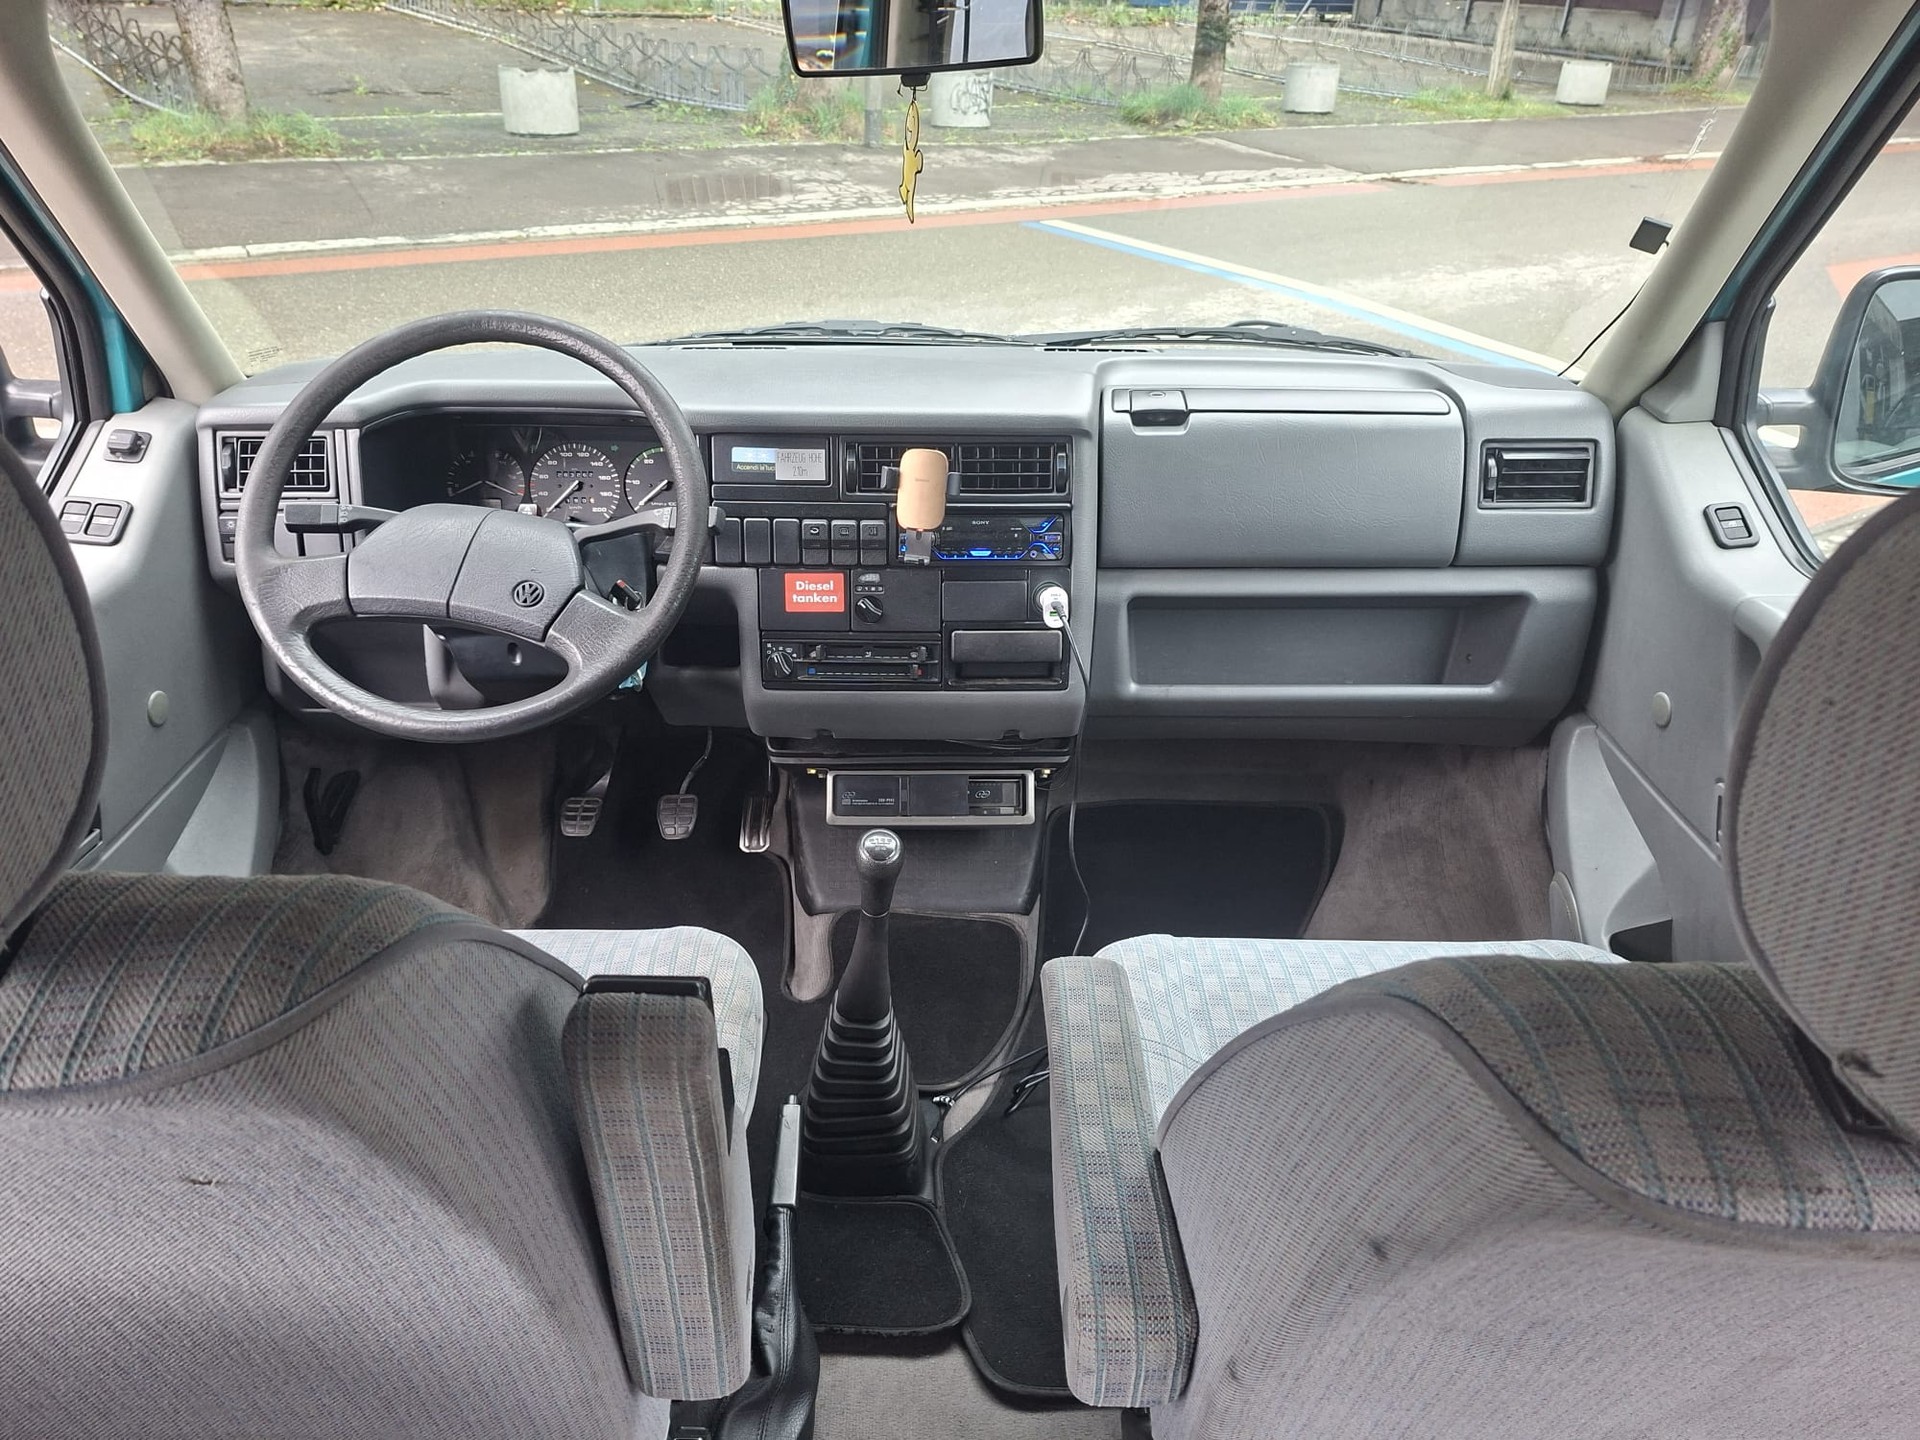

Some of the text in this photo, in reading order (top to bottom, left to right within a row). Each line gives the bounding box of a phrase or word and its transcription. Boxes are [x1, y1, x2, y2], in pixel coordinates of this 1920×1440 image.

[736, 463, 759, 471] Accendi
[795, 580, 834, 591] Diesel
[792, 593, 838, 603] tanken
